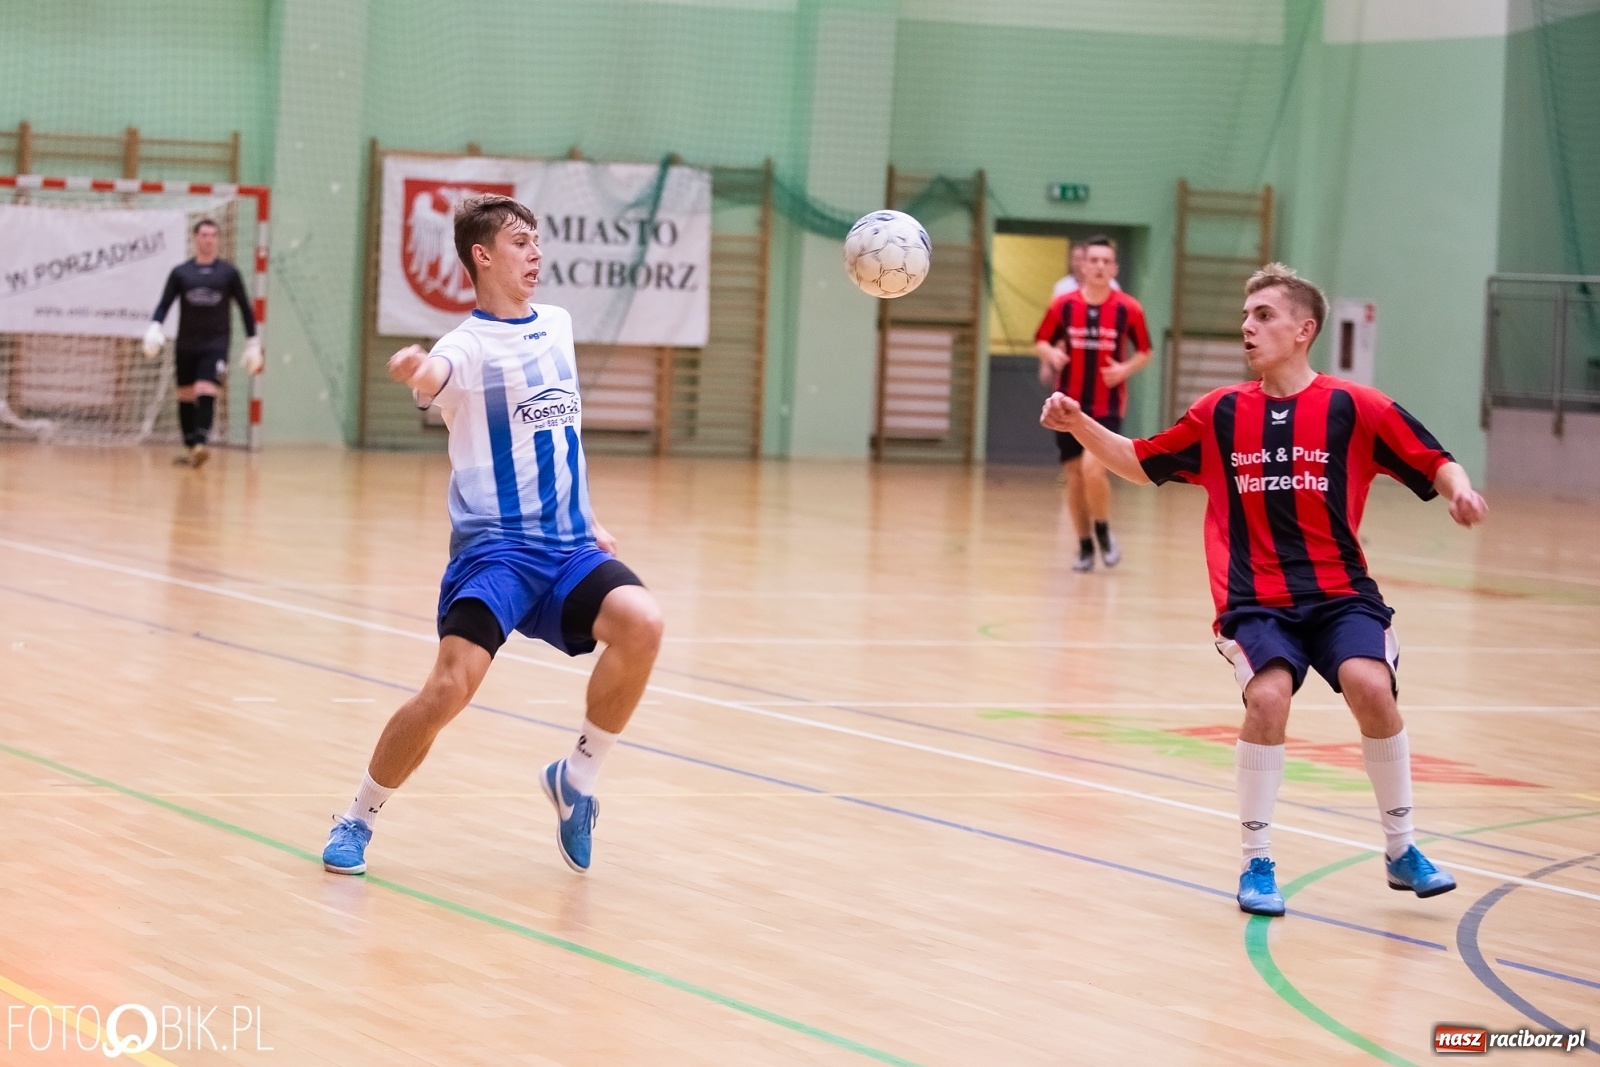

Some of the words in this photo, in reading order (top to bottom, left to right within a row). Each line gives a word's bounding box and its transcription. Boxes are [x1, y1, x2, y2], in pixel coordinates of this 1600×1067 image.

[543, 214, 679, 247] MIASTO
[538, 257, 699, 293] ACIBORZ
[523, 331, 547, 340] regio
[1230, 448, 1271, 467] Stuck
[1275, 447, 1288, 462] &
[1292, 446, 1330, 463] Putz
[1234, 471, 1329, 494] Warzecha
